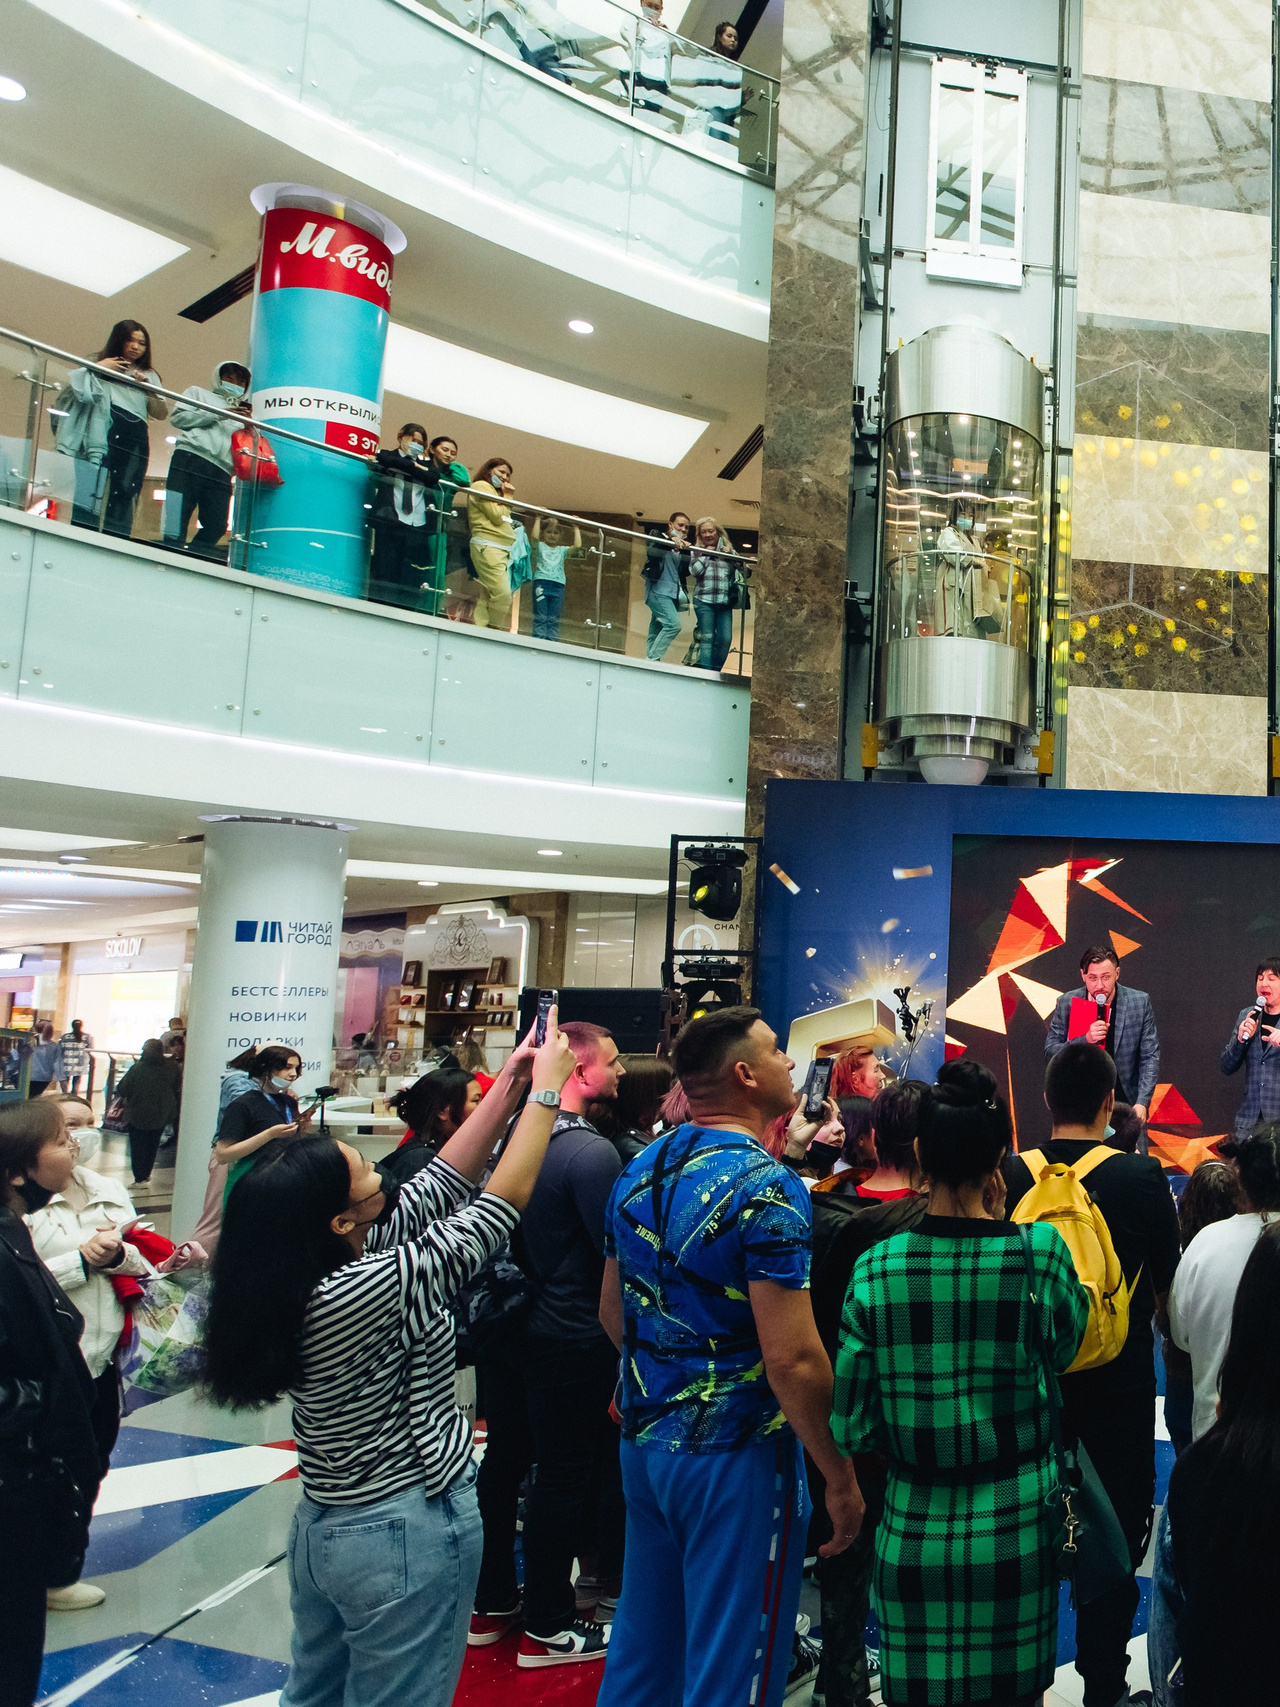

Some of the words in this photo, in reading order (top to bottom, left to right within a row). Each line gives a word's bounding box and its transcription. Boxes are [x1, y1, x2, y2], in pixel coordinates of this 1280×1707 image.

[280, 222, 392, 296] М.вид
[264, 397, 294, 409] МЫ
[347, 433, 359, 446] 3
[288, 921, 333, 934] ЧИТАЙ
[287, 933, 332, 946] ГОРОД
[105, 937, 143, 958] SOKOLOV
[231, 986, 329, 997] БЕСТСЕЛЛЕРЫ
[229, 1011, 307, 1022] НОВИНКИ
[227, 1036, 305, 1048] ПОДКИ
